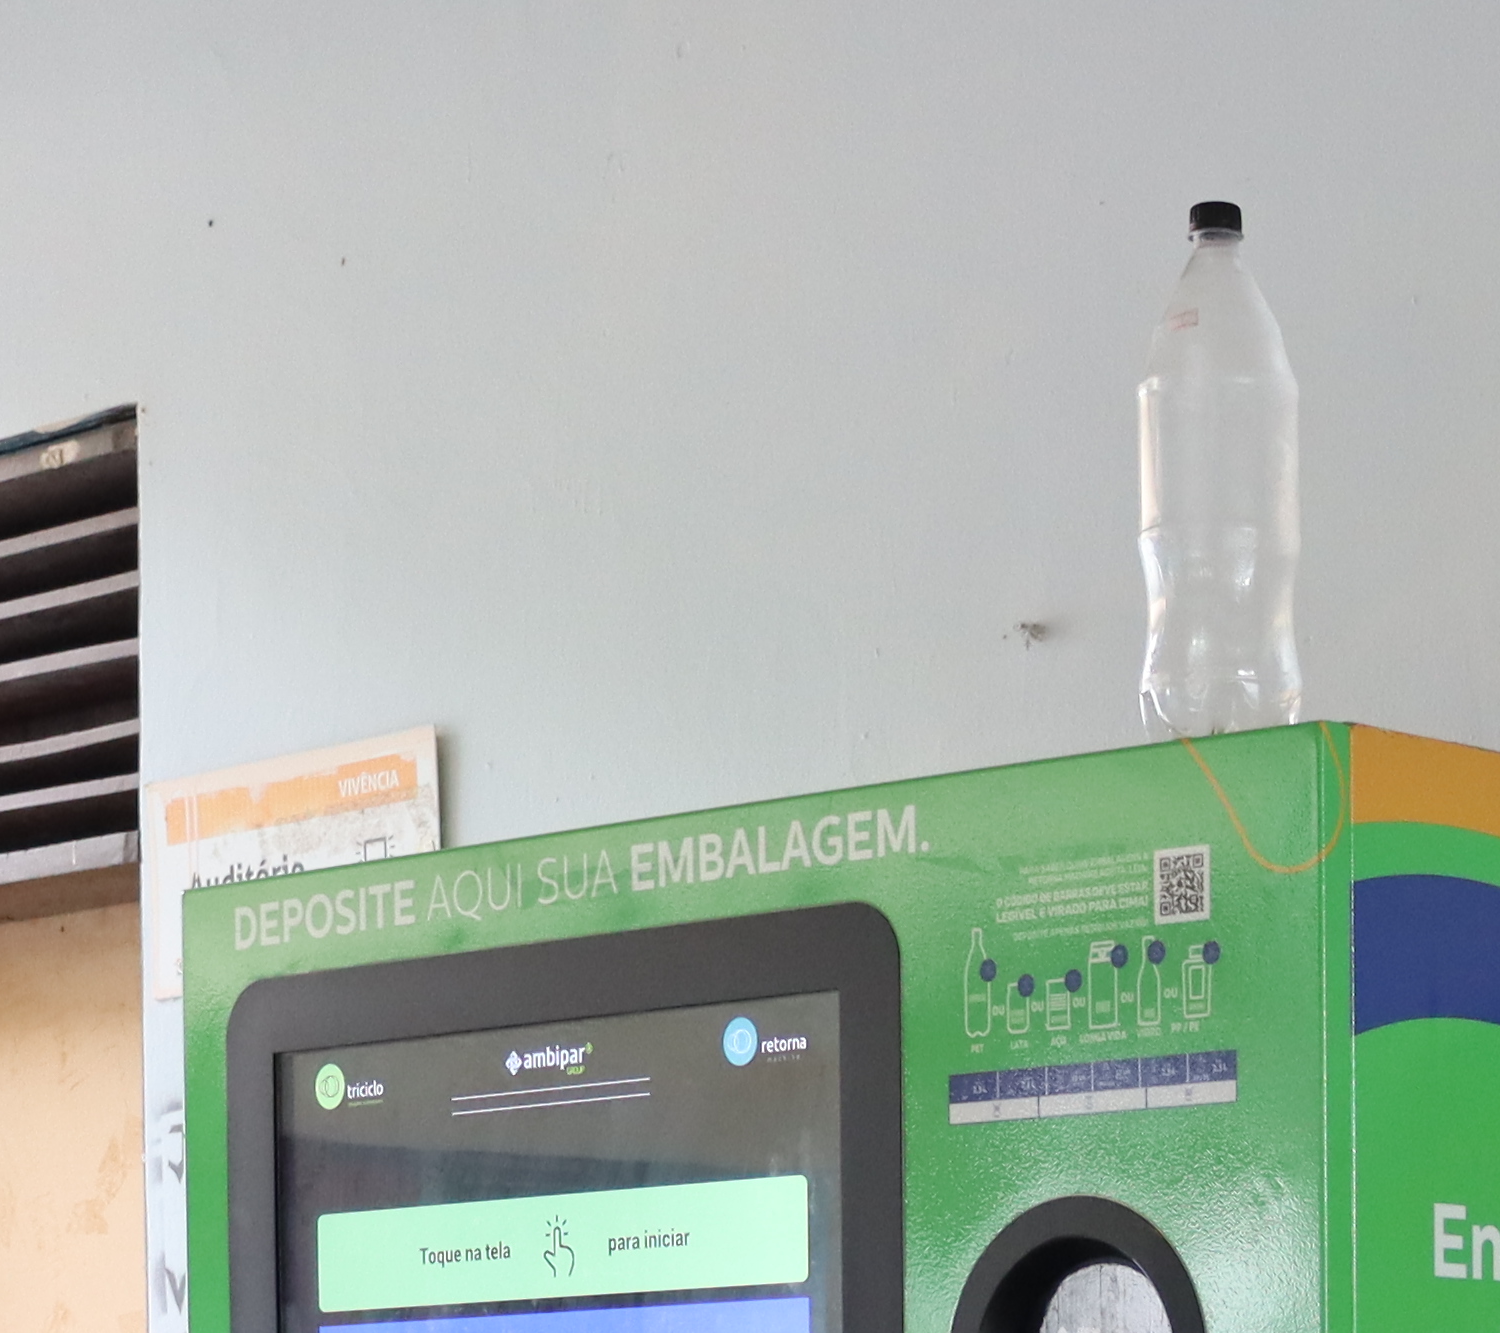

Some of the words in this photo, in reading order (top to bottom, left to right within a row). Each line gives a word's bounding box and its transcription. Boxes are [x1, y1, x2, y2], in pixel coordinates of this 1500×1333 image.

[338, 768, 400, 797] VIVÊNCIA
[234, 879, 417, 951] DEPOSITE
[426, 863, 523, 921] AQUI
[537, 849, 619, 906] SUA
[630, 804, 931, 892] EMBALAGEM.
[1088, 898, 1117, 913] PARA
[992, 1005, 1005, 1016] OU
[1031, 1002, 1044, 1012] OU
[1073, 997, 1086, 1008] OU
[1121, 992, 1134, 1003] OU
[1164, 988, 1178, 999] OU
[522, 1043, 586, 1071] ambipar
[760, 1036, 807, 1054] retorna
[346, 1080, 385, 1100] triciclo
[419, 1246, 462, 1268] Toque
[464, 1247, 483, 1262] na
[484, 1242, 511, 1261] tela
[607, 1232, 641, 1257] para
[644, 1228, 690, 1250] iniciar
